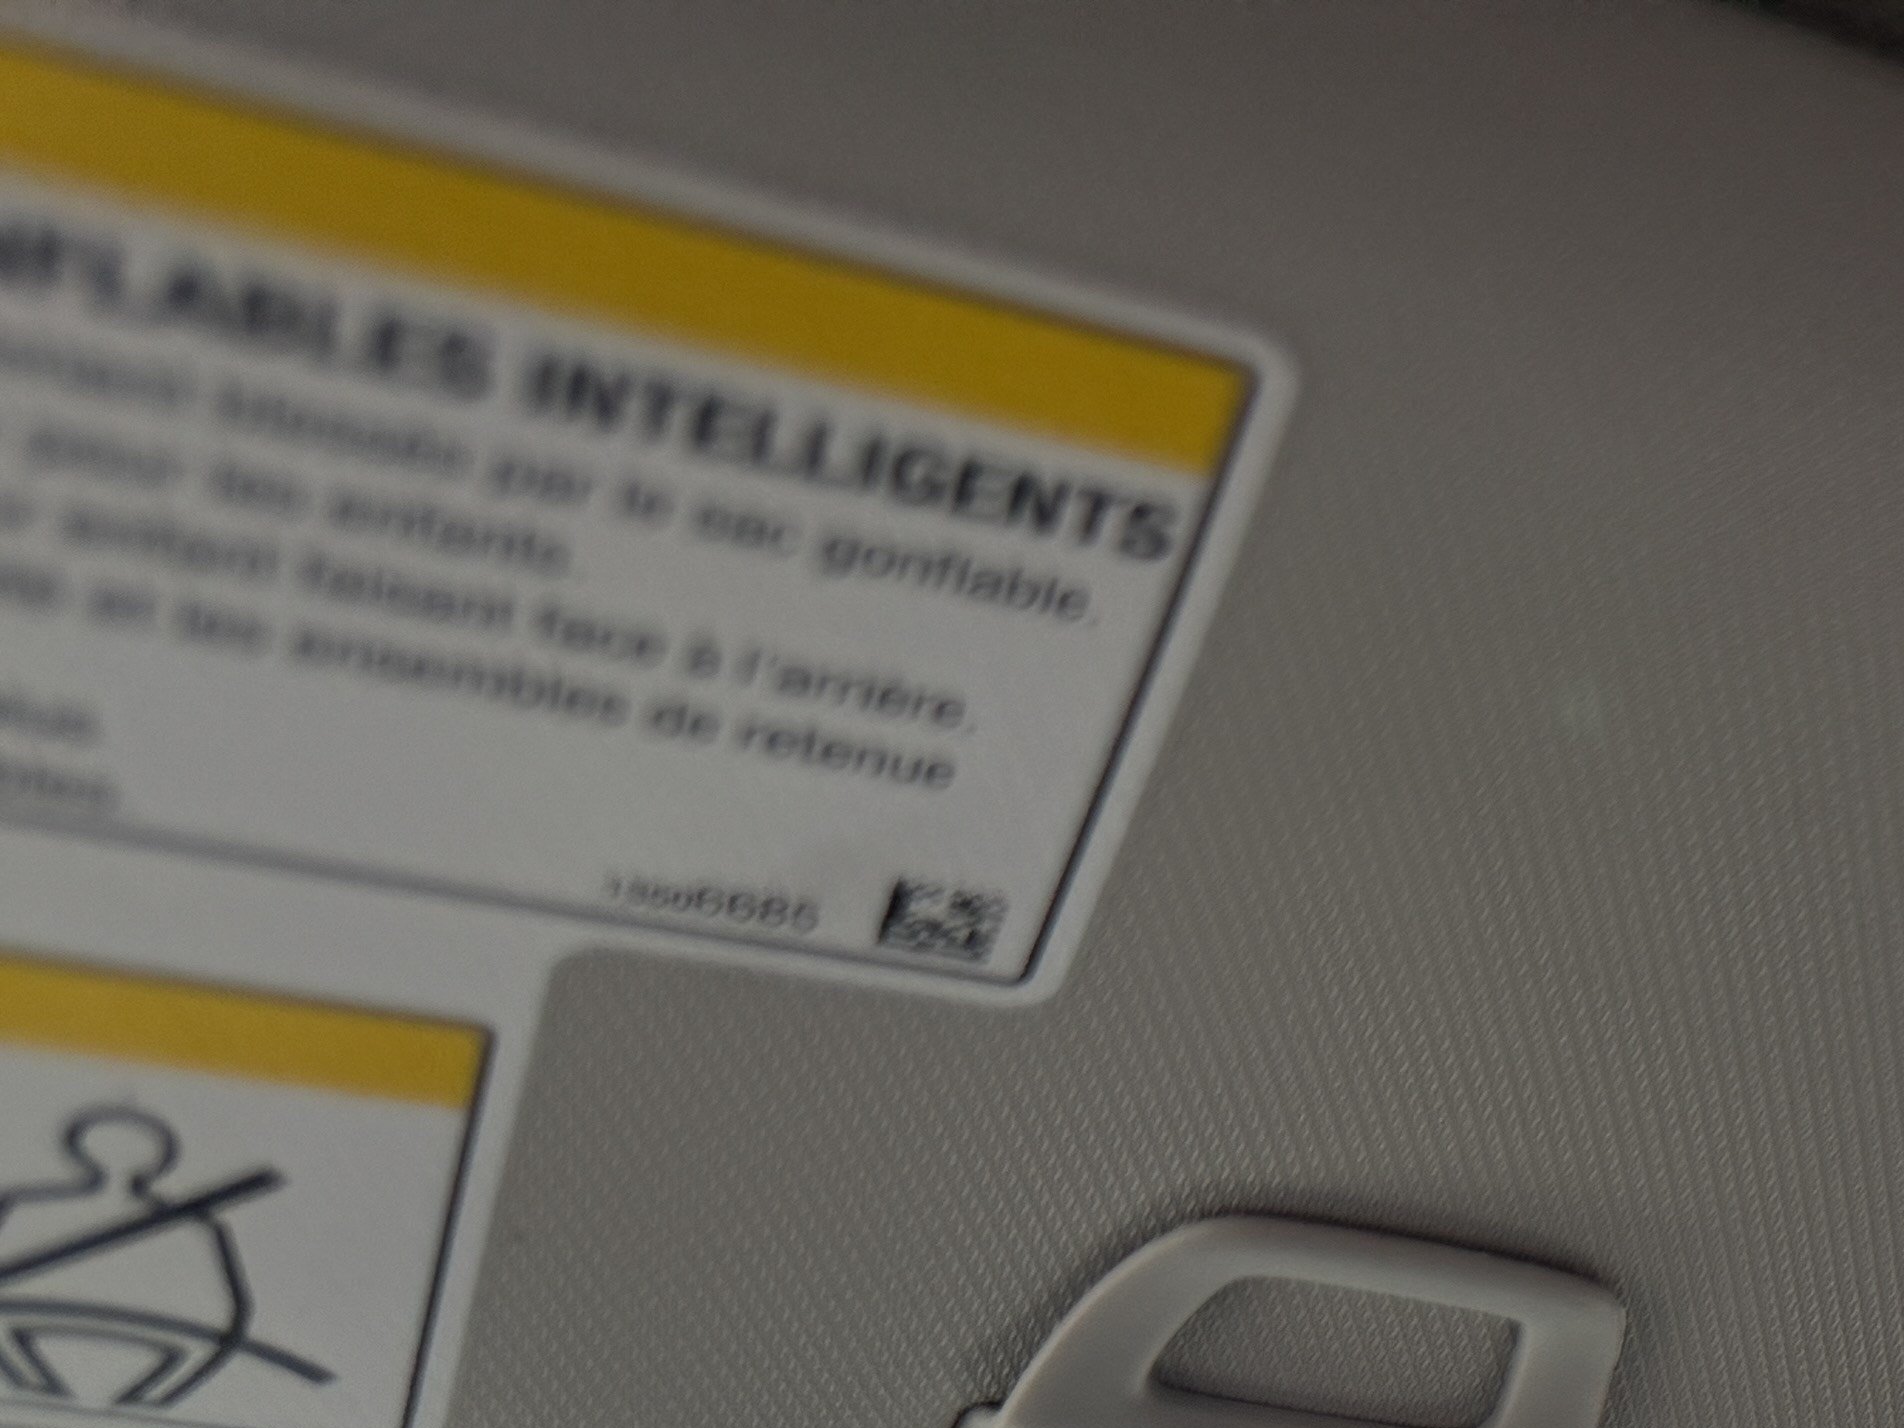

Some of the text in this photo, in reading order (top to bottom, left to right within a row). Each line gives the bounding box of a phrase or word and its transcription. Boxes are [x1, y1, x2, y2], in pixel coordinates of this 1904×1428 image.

[528, 352, 1180, 562] INTELLIGENTS
[819, 530, 1098, 627] gonflable.
[735, 645, 978, 737] l'arrière.
[646, 695, 722, 747] de
[736, 710, 957, 792] retenue
